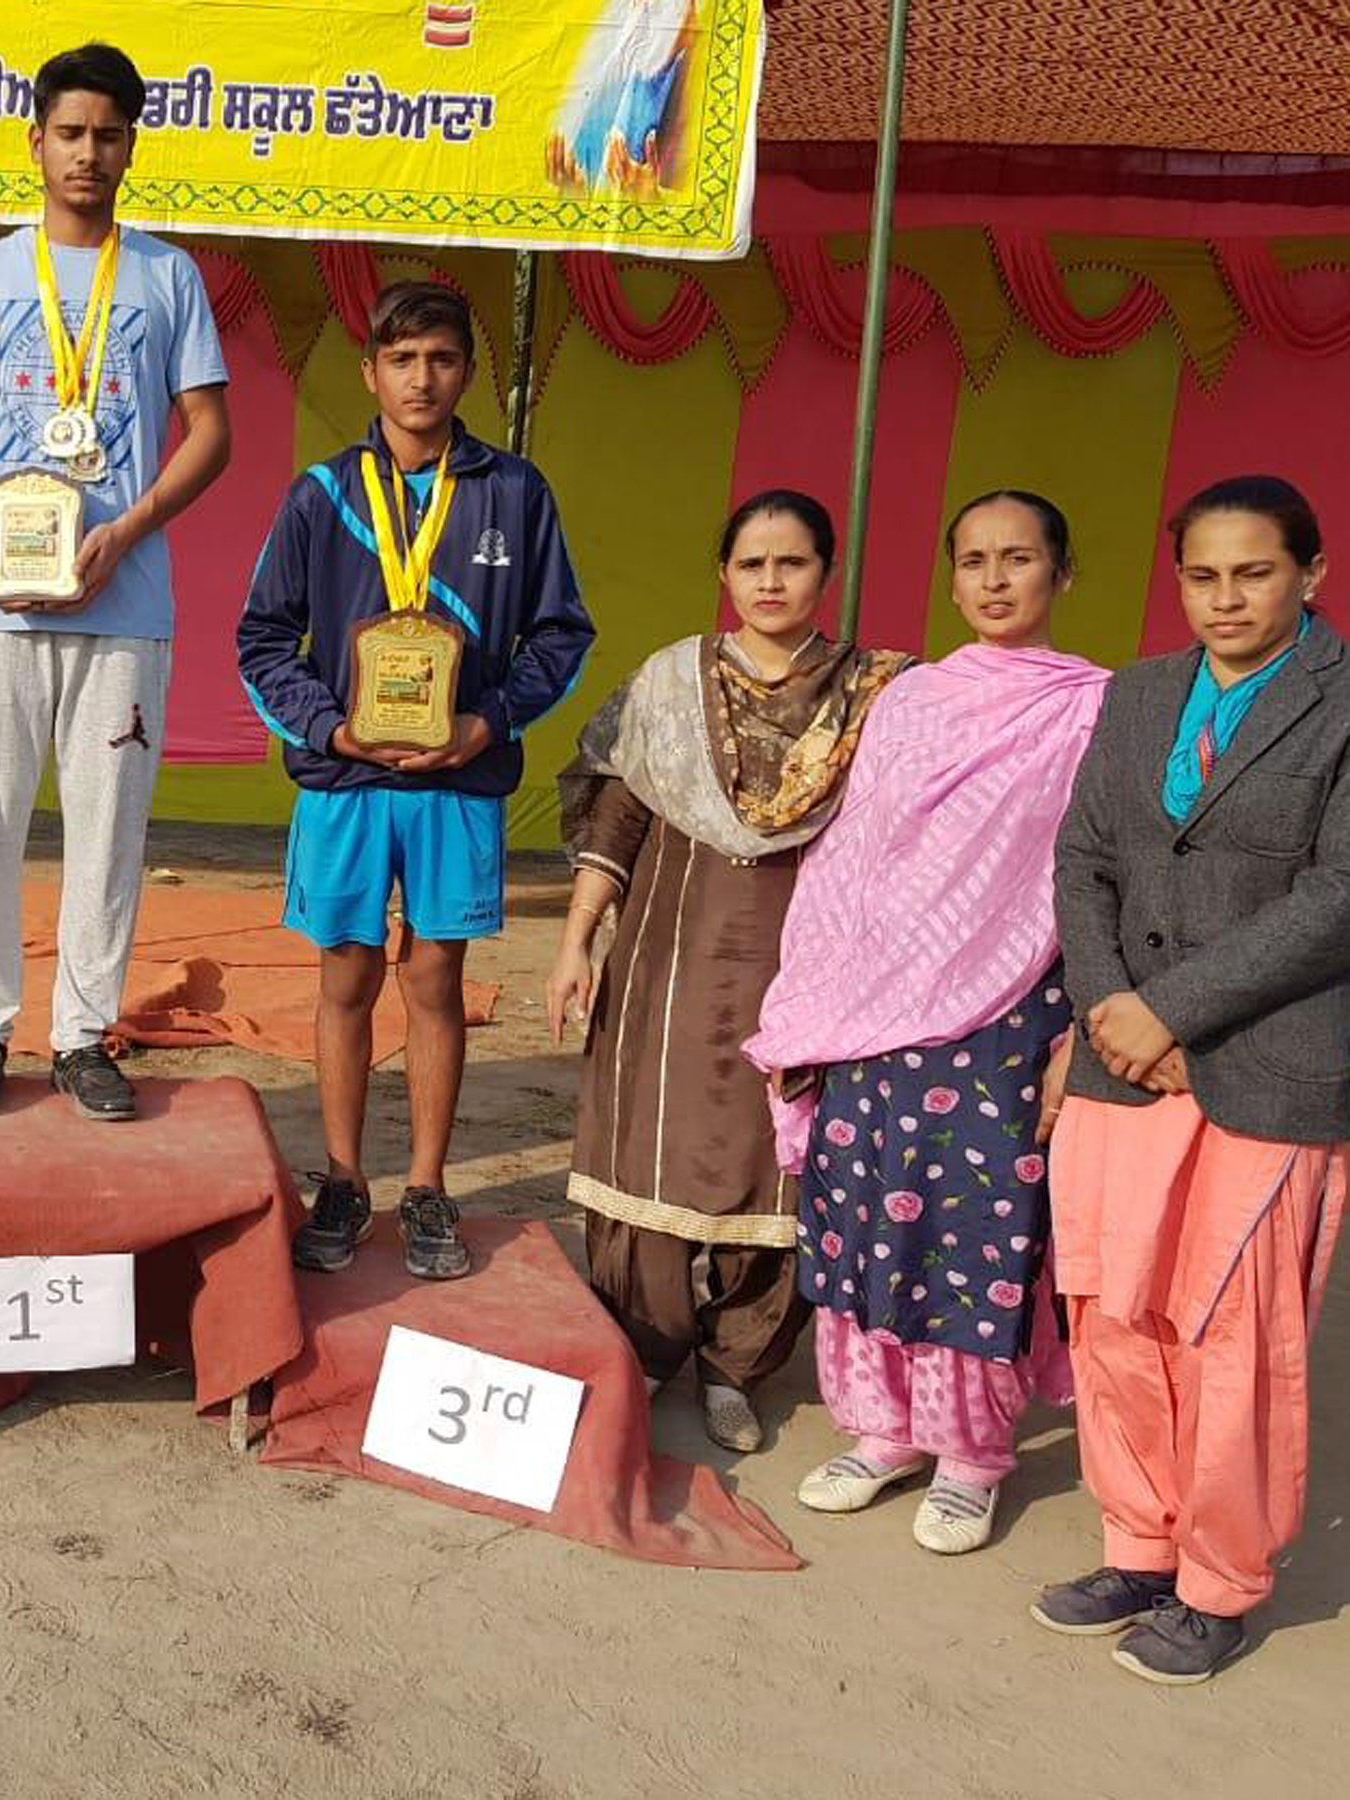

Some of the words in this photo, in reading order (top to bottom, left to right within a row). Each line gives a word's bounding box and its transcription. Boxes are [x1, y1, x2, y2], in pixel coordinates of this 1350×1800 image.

[222, 83, 315, 156] ਸਕੂਲ
[5, 1273, 85, 1343] 1st
[427, 1383, 535, 1445] 3rd
